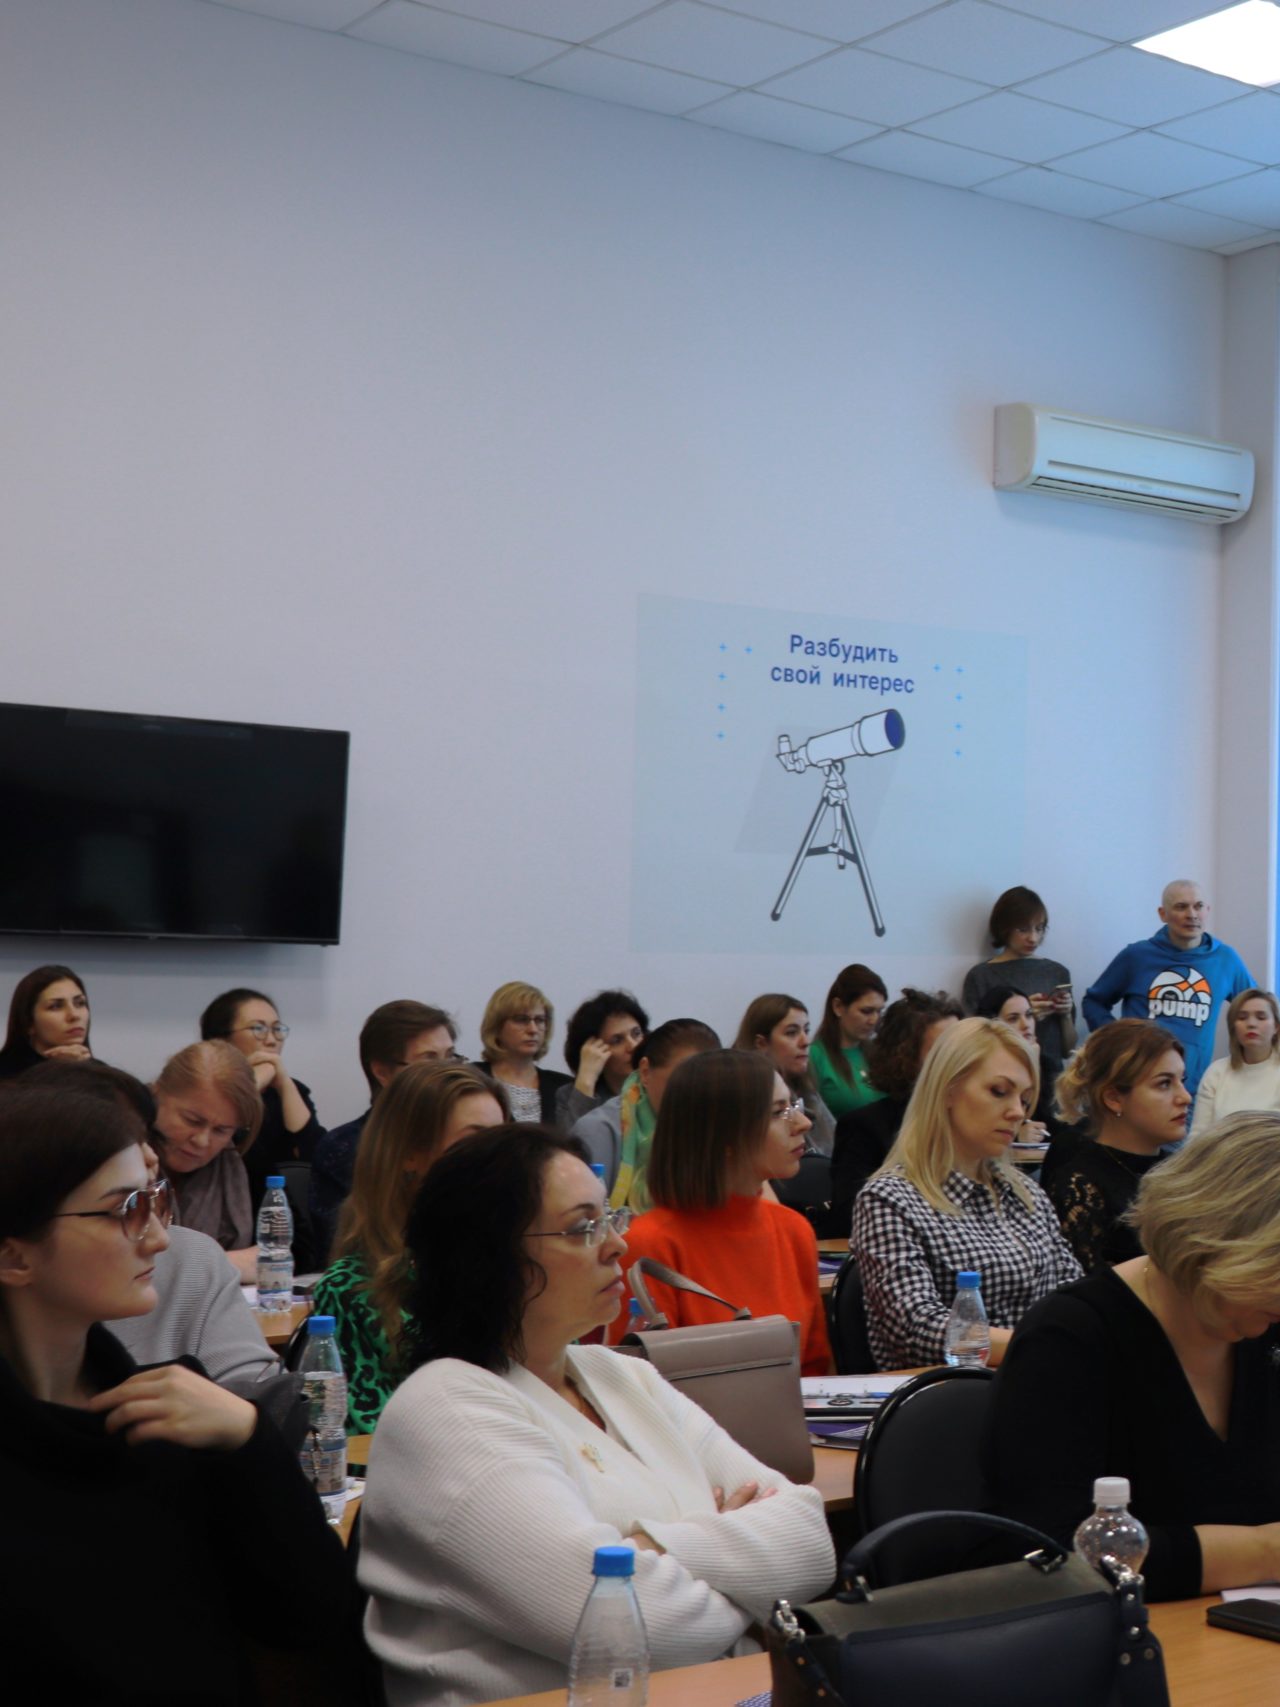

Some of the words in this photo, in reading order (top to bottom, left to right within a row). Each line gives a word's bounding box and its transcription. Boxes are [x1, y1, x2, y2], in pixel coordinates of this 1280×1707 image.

[790, 634, 899, 663] Разбудить
[770, 665, 821, 685] свой
[832, 672, 915, 696] интерес
